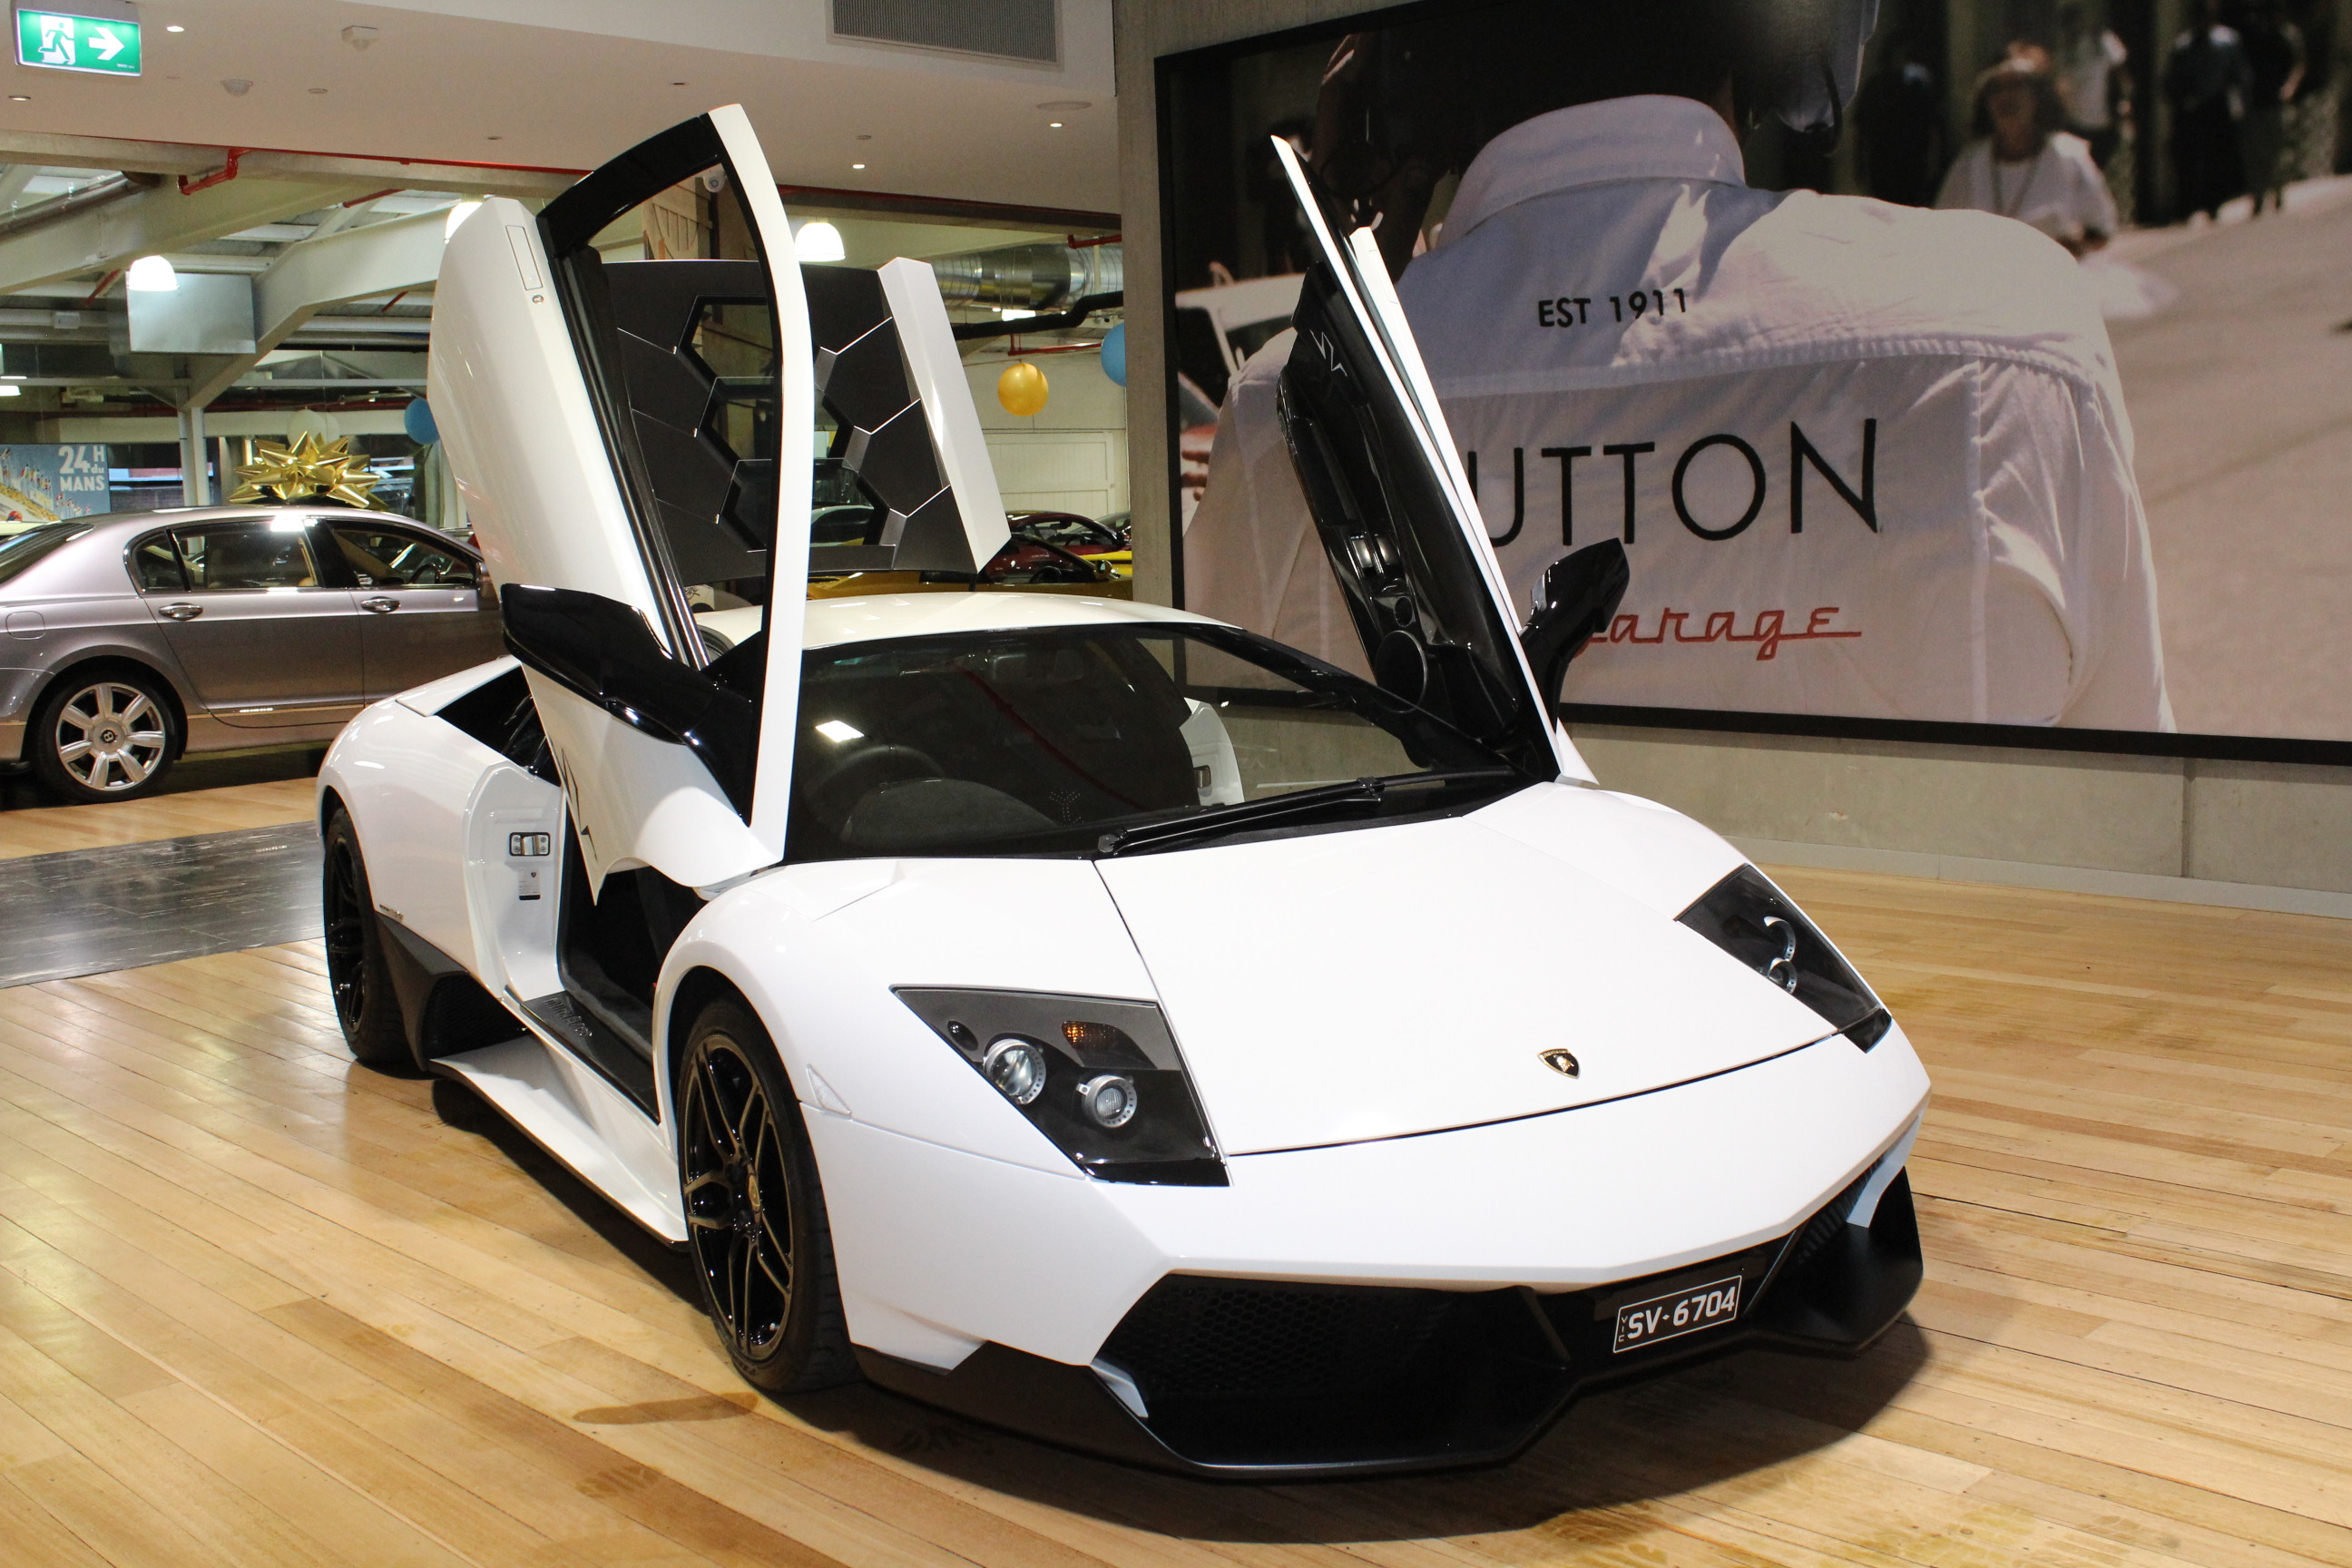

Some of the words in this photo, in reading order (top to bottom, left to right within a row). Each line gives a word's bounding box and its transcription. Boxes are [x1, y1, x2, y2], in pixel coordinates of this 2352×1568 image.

[1538, 298, 1591, 328] EST
[1610, 288, 1686, 322] 1911
[60, 475, 105, 492] MANS
[90, 464, 104, 474] du
[1466, 417, 1878, 548] UTTON
[1573, 607, 1862, 661] arage
[1618, 1316, 1629, 1342] VIC
